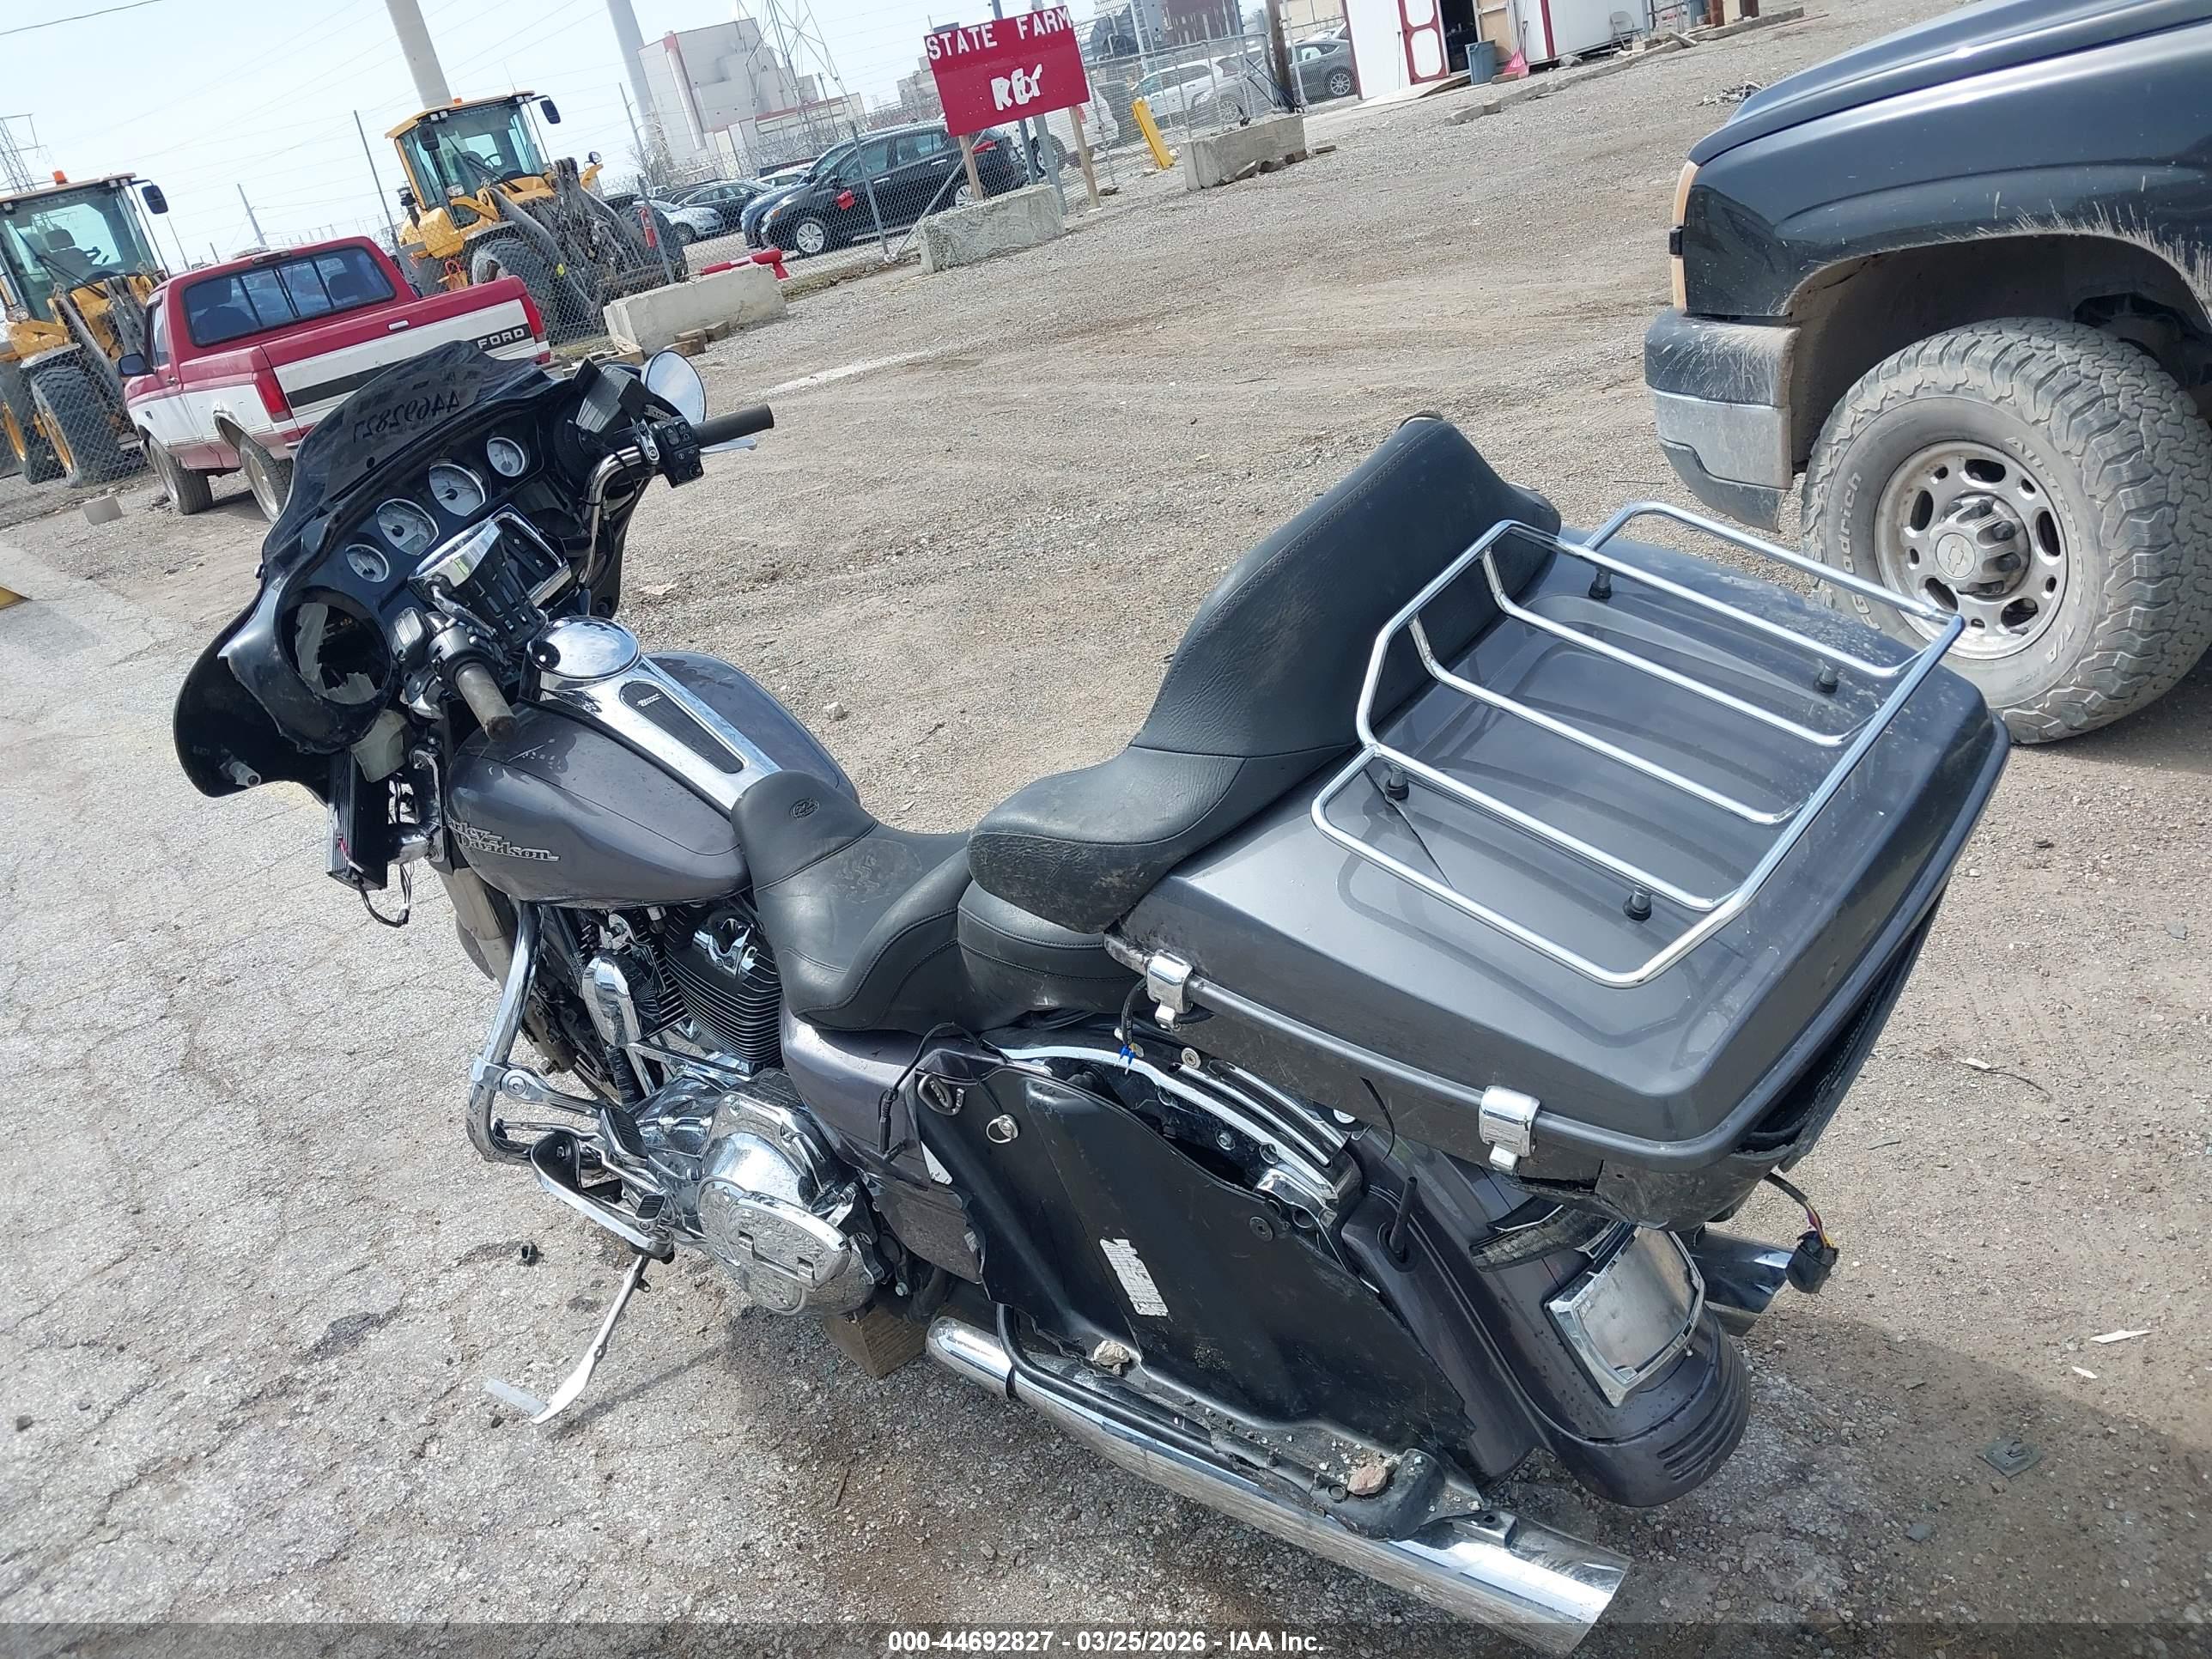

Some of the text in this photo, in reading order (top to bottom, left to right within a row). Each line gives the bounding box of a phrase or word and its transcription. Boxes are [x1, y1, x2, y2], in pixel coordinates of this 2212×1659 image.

[926, 6, 1073, 60] STATE FARM
[477, 328, 525, 349] FORD
